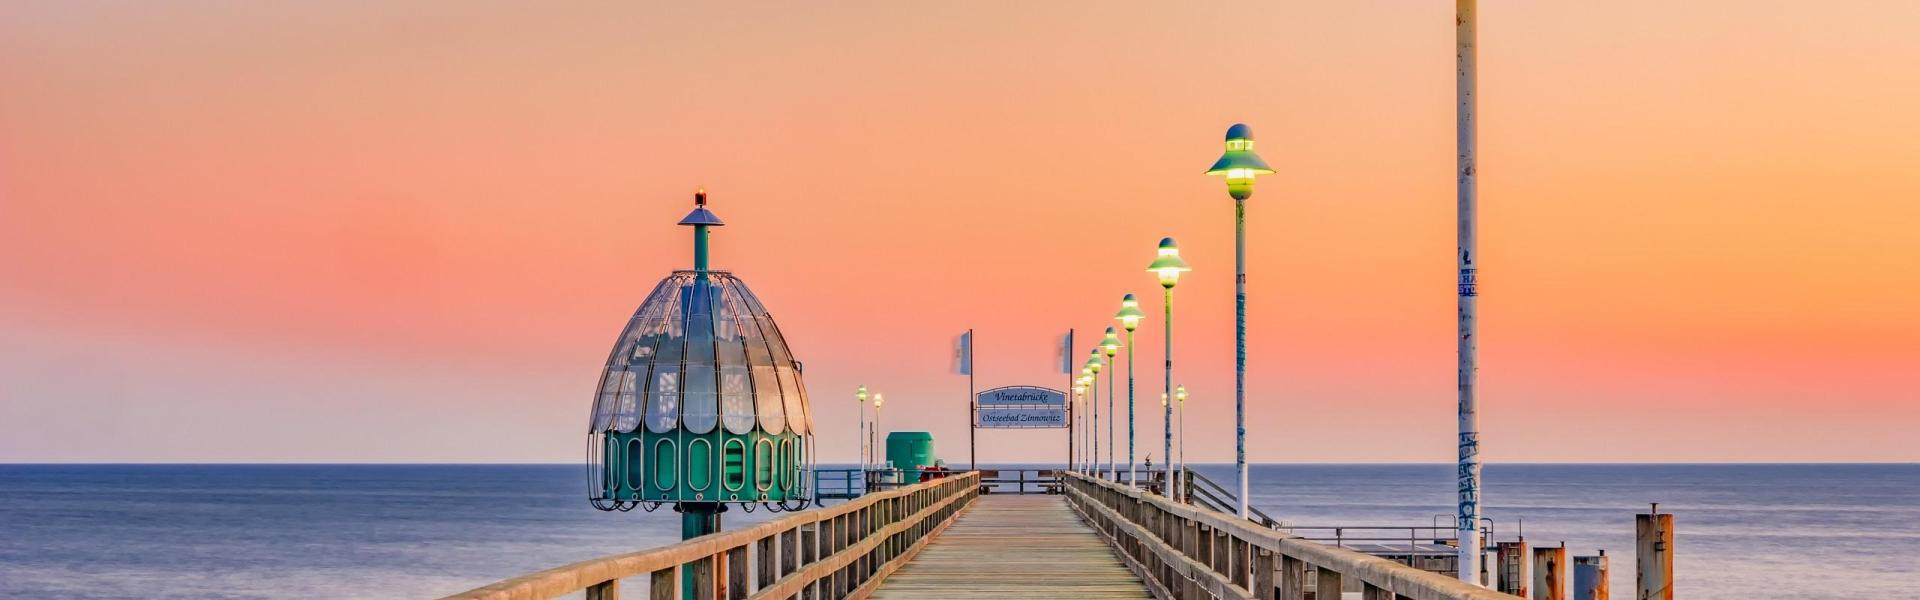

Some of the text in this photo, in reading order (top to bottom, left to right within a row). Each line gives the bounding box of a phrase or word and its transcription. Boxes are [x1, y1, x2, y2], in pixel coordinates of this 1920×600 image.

[995, 392, 1048, 403] Vinetabrücke
[983, 414, 1061, 423] Ostseebad Zinnowitz
